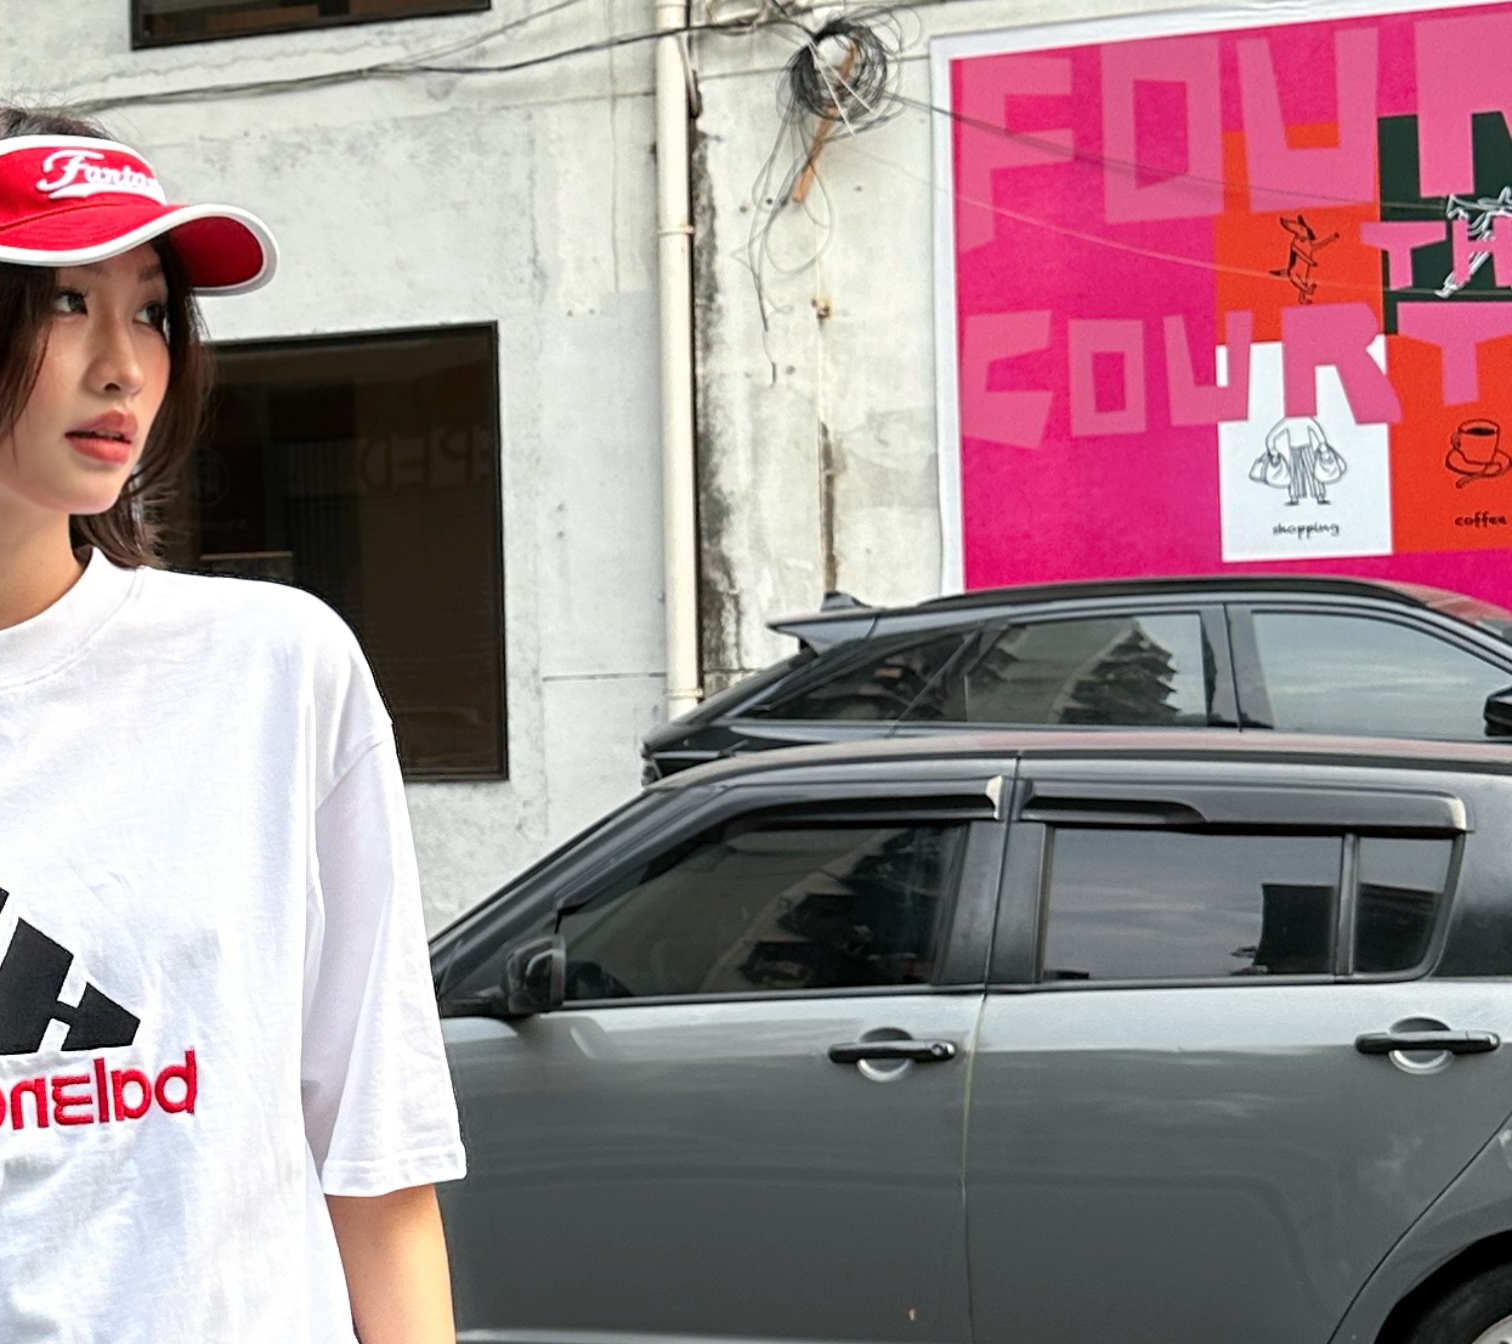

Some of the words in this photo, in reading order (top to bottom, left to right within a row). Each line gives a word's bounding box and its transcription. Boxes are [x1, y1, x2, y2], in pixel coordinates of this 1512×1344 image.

[962, 301, 1512, 450] COURT
[1455, 511, 1507, 528] coffee
[1272, 522, 1340, 540] shopping
